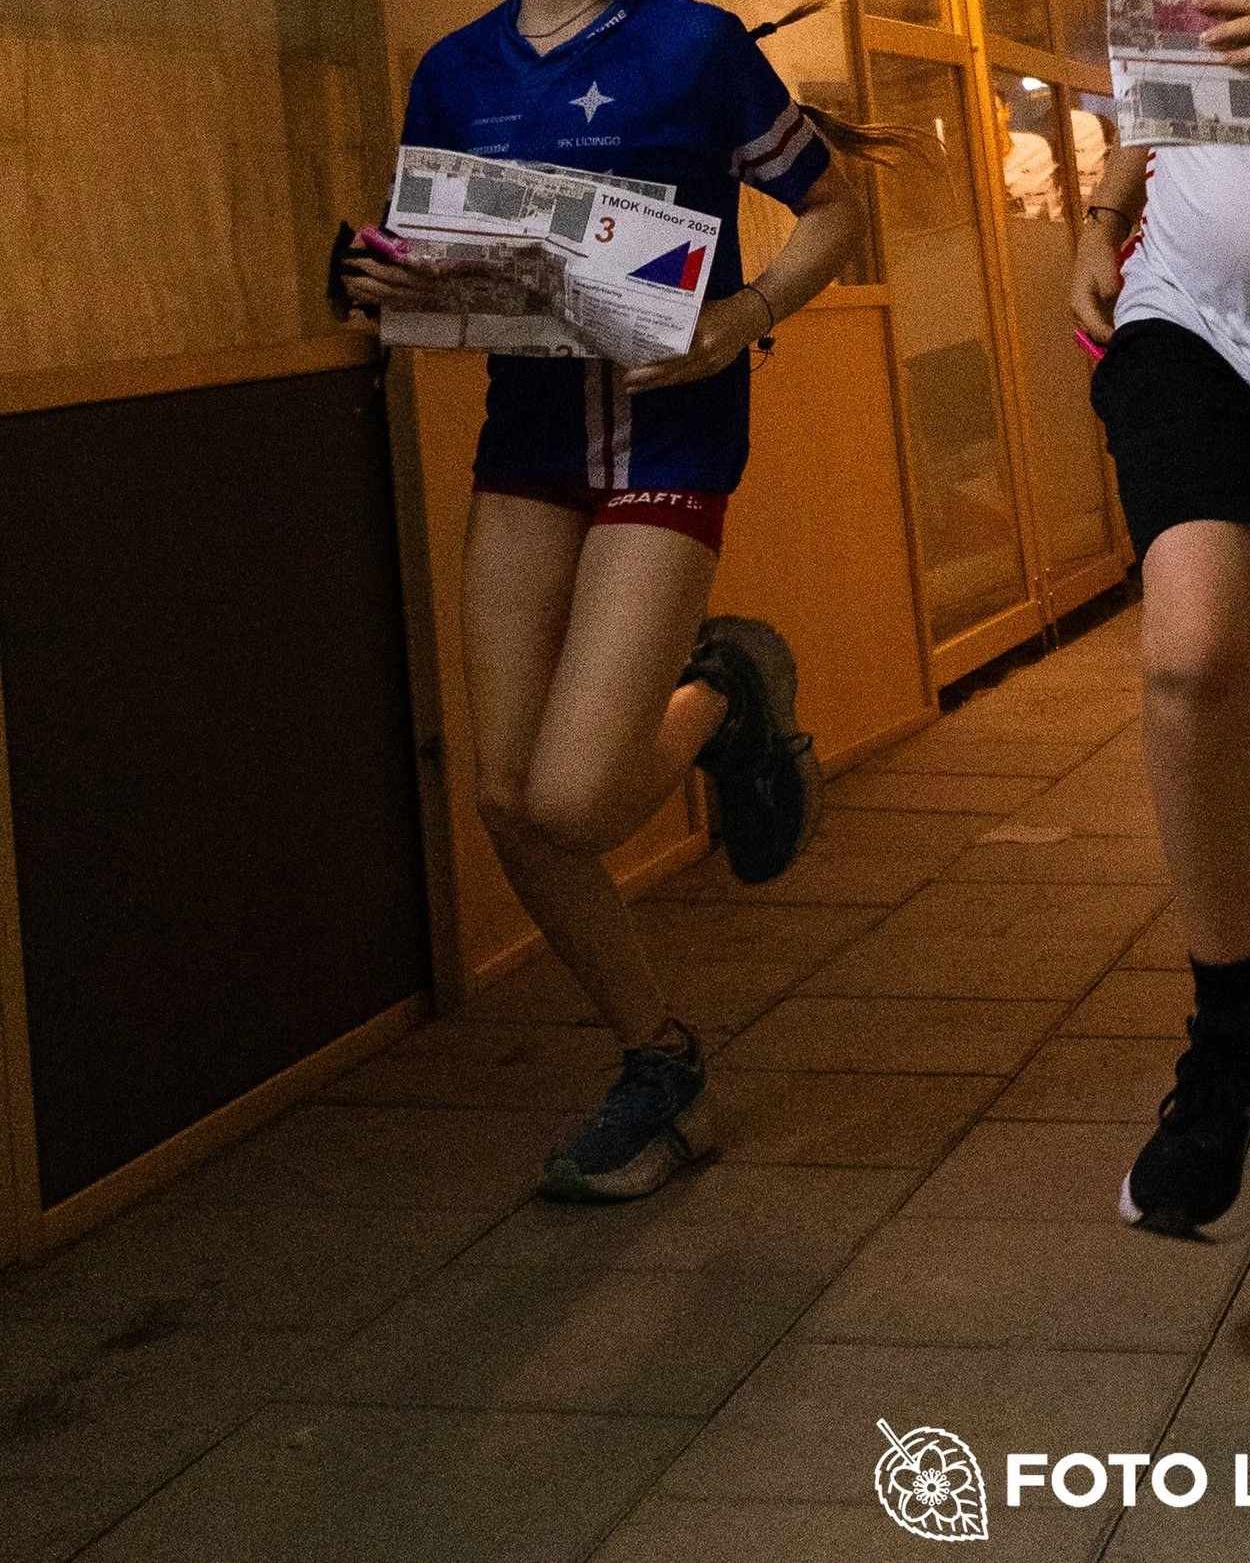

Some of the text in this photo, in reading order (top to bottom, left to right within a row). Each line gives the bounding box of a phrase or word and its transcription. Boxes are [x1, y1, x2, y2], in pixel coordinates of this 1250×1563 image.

[601, 194, 718, 237] TMOK Indoor 2025
[594, 216, 616, 244] 3
[607, 492, 683, 509] CRAFT
